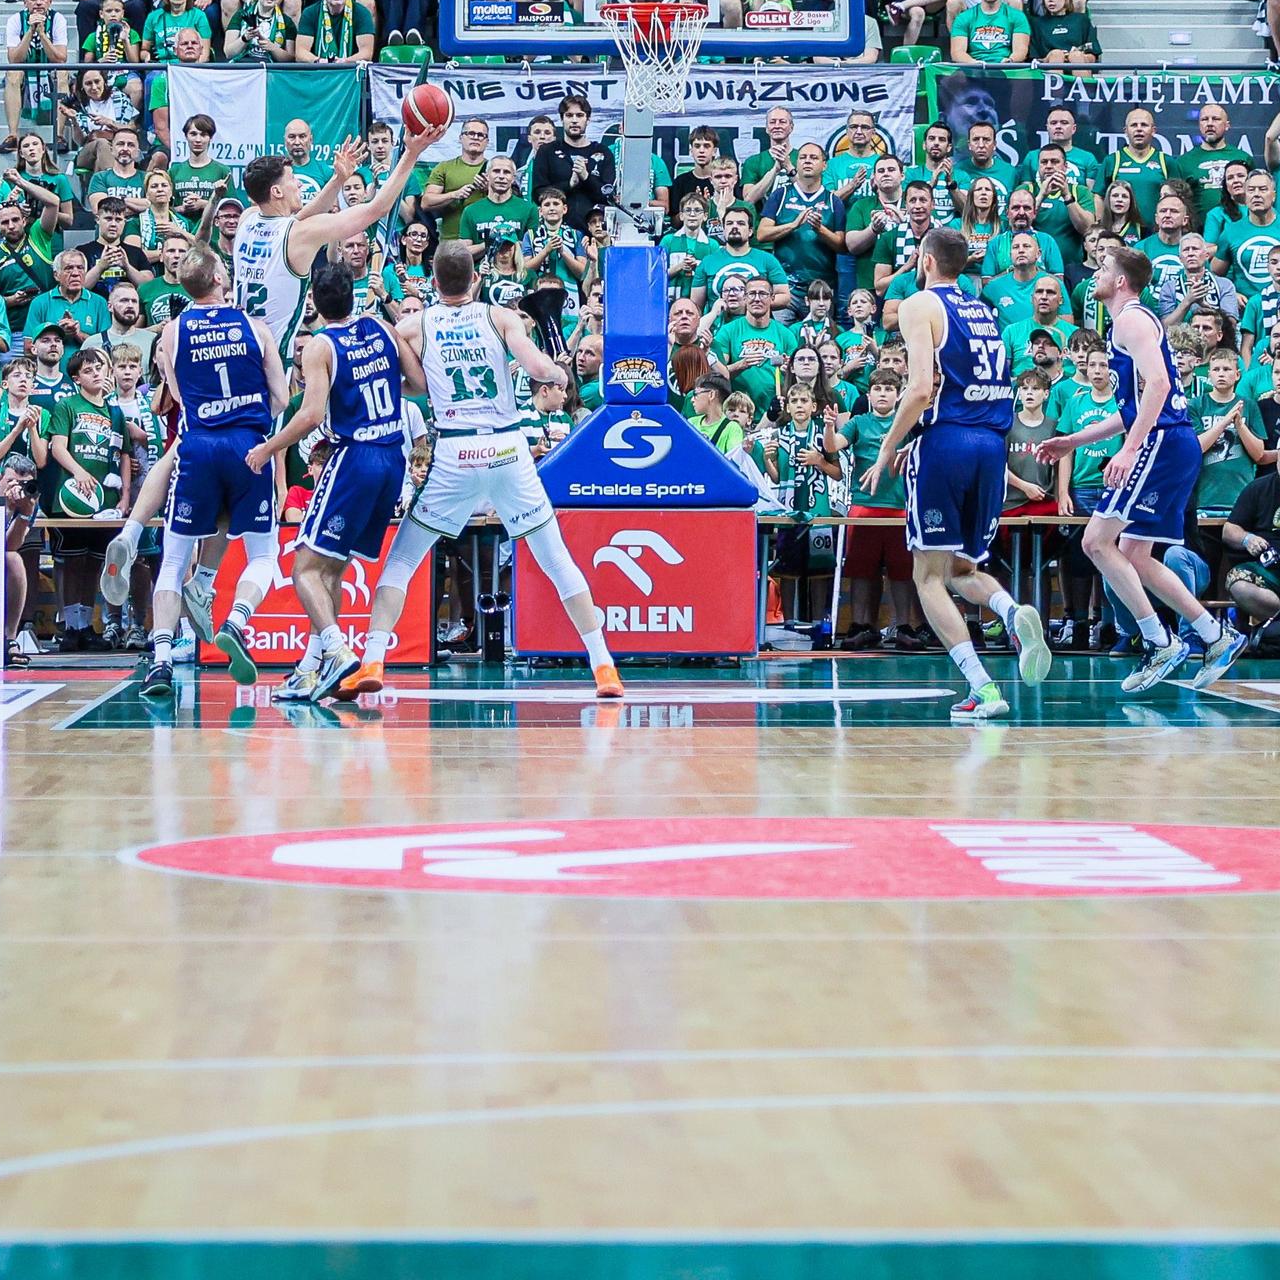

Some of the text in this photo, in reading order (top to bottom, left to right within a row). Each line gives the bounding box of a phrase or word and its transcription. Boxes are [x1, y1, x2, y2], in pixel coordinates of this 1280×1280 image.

[472, 4, 513, 16] molten
[749, 13, 788, 25] ORLEN
[807, 18, 821, 26] Liga
[1042, 72, 1280, 113] PAMIĘTAMY
[189, 332, 225, 345] netia
[190, 343, 247, 363] ZYSKOWSKI
[440, 347, 487, 364] SZUMERT
[970, 339, 1007, 381] 37
[214, 362, 231, 397] 1
[445, 365, 498, 402] 13
[609, 366, 639, 384] Zielona
[197, 393, 262, 419] GDYNIA
[359, 378, 395, 420] 10
[458, 446, 496, 460] BRICO
[1083, 447, 1108, 458] FAMILY
[569, 483, 705, 500] Schelde Sports
[241, 623, 399, 651] Bank eko
